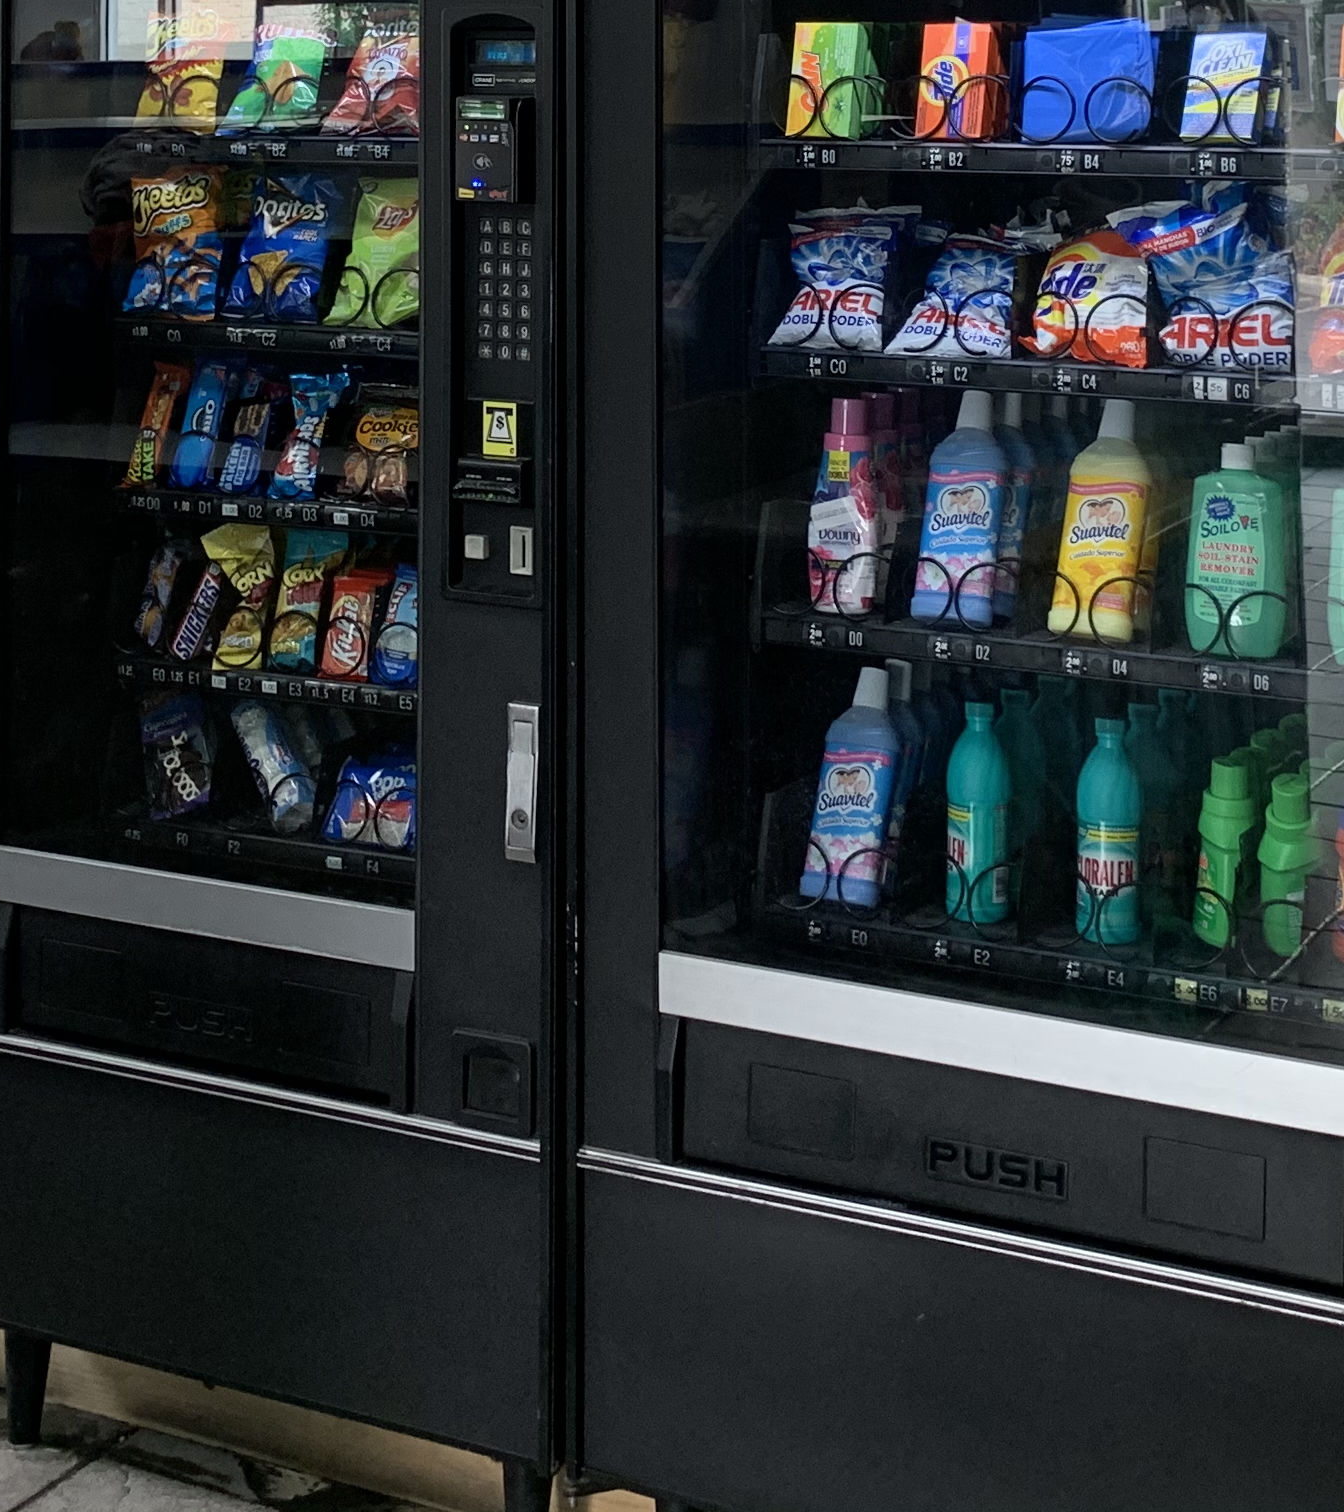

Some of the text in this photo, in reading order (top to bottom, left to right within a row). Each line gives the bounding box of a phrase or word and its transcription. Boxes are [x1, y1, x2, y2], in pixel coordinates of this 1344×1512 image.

[1209, 41, 1245, 60] OXI
[1197, 52, 1254, 74] CLEAN
[948, 152, 963, 166] B2
[1084, 154, 1099, 170] B4
[1221, 158, 1236, 173] B6
[790, 289, 878, 315] ARIEL
[783, 315, 874, 326] DOBLE PODER
[1160, 314, 1287, 348] ARIEL
[954, 367, 968, 381] C2
[1082, 374, 1096, 390] C4
[1235, 383, 1249, 398] C6
[931, 511, 989, 531] Suavitel
[1069, 524, 1129, 543] Suavitel
[1202, 542, 1255, 554] LAUNDRY
[1198, 552, 1259, 565] SOIL-STAIN
[1200, 563, 1255, 576] REMOVER
[173, 579, 220, 659] SNICKERS
[239, 677, 251, 691] E2
[289, 683, 301, 696] E3
[819, 792, 873, 810] Suavitel
[1108, 972, 1124, 986] E4
[929, 1141, 1066, 1197] PUSH
